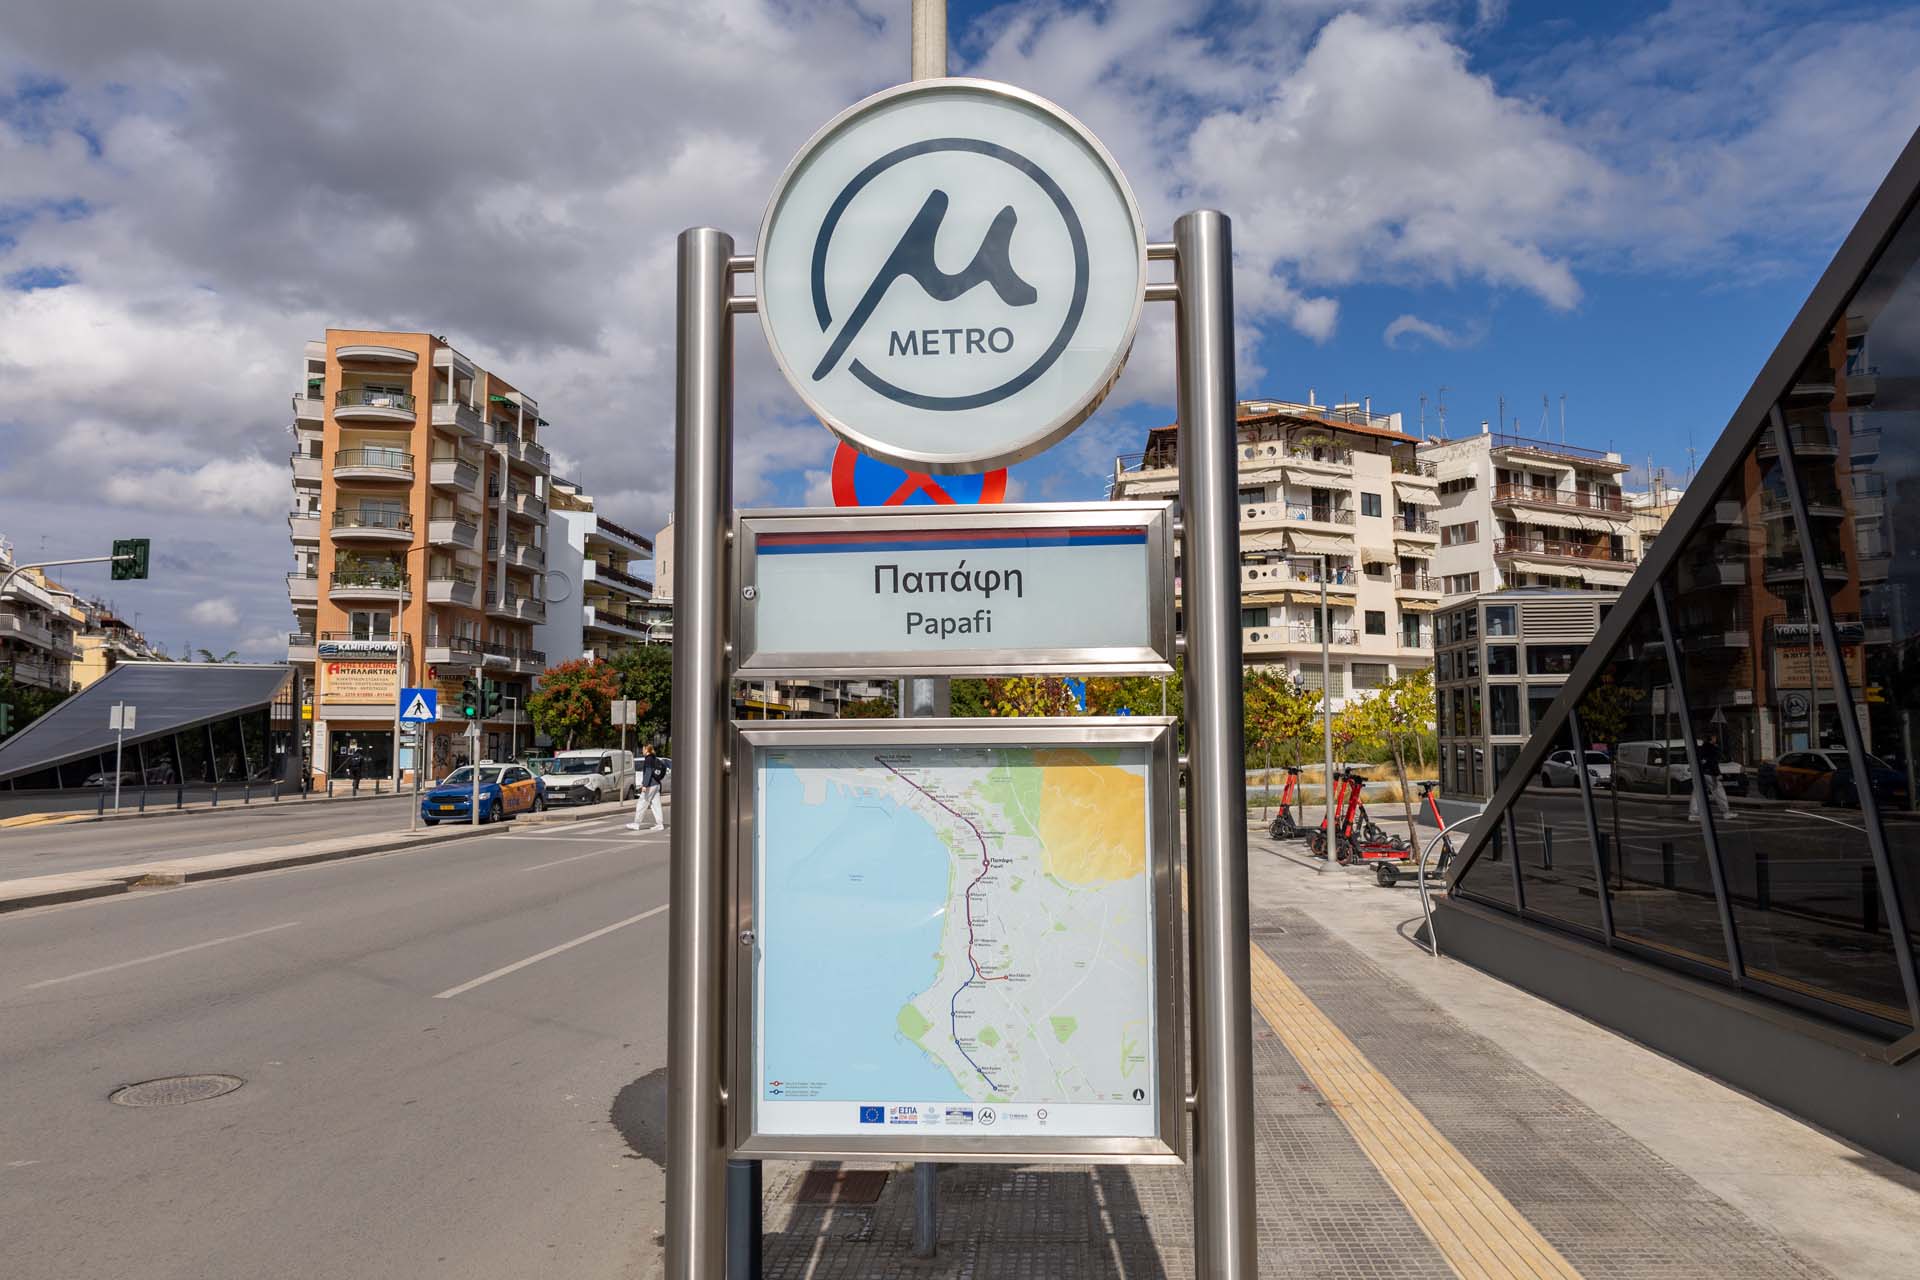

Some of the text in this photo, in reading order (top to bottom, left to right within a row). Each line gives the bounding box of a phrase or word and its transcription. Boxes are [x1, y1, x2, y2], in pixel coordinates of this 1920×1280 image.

[888, 327, 1014, 356] METRO
[874, 560, 1023, 598] Παπάφη
[906, 610, 992, 640] Papafi
[338, 643, 398, 651] ΚΑΜΠΕΡΟΓΛΟ
